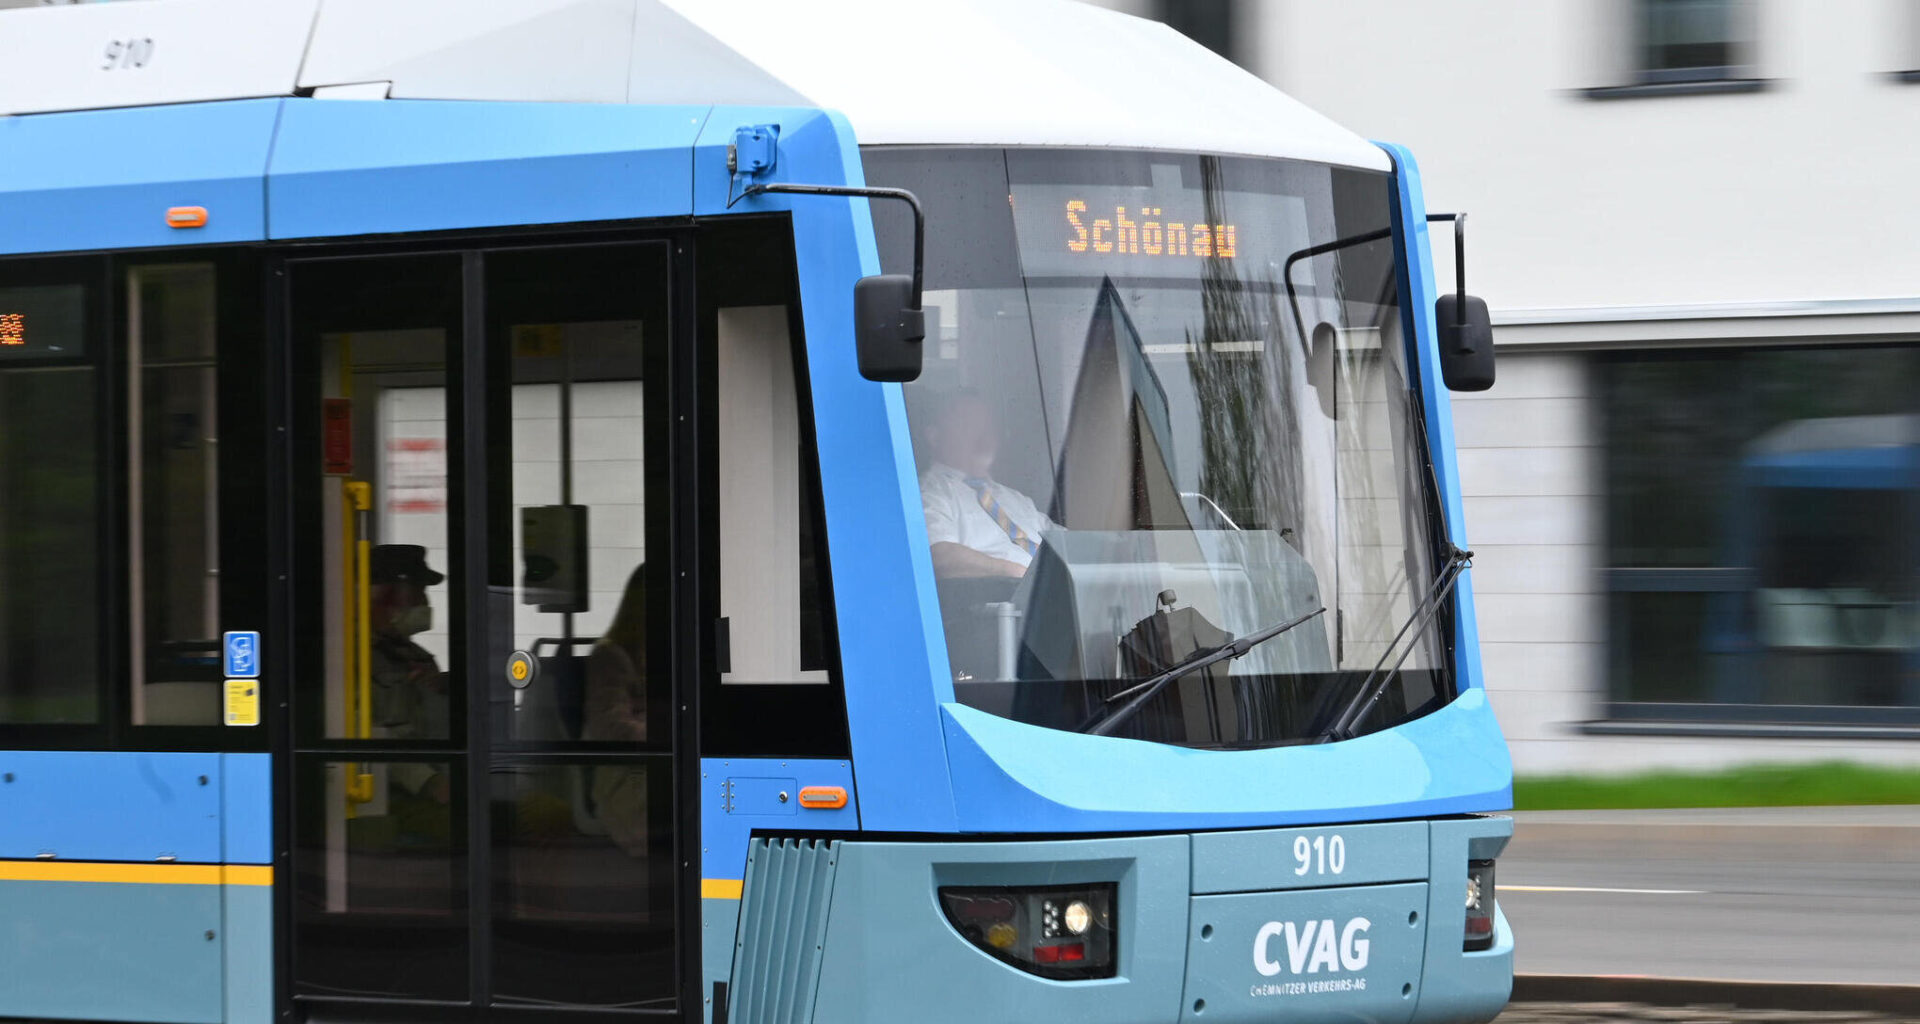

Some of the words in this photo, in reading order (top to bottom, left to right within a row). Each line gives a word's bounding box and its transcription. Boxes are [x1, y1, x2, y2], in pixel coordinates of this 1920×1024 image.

[101, 38, 155, 71] 910
[1066, 200, 1236, 258] Schönau
[1293, 834, 1346, 876] 910
[1253, 916, 1372, 977] CVAG
[1307, 978, 1367, 994] VERKEHRS-AG
